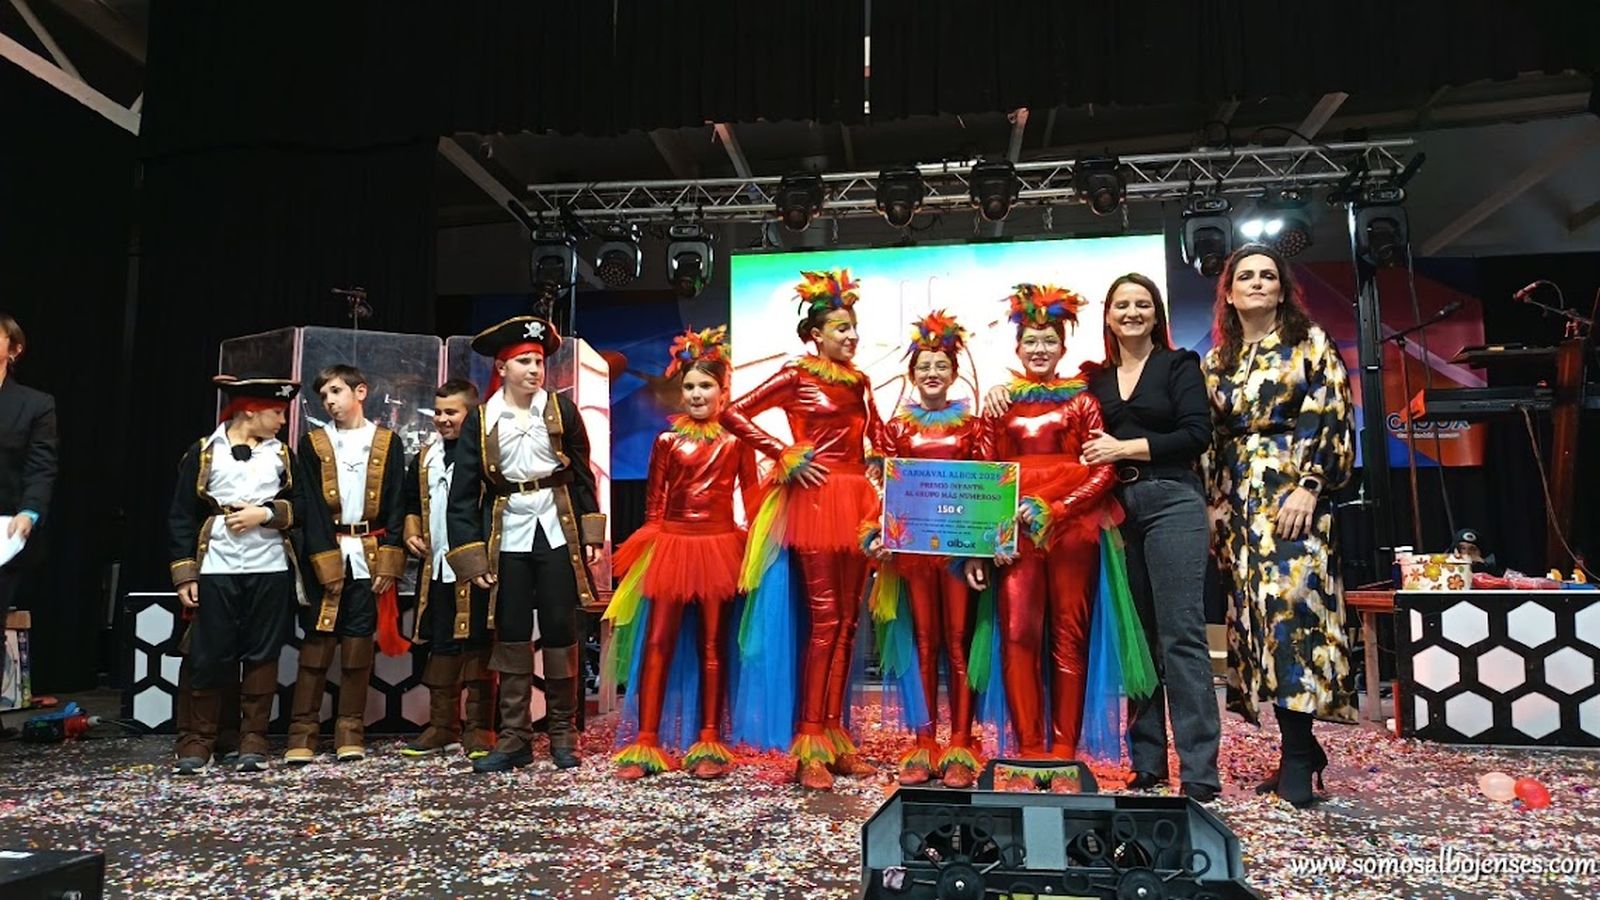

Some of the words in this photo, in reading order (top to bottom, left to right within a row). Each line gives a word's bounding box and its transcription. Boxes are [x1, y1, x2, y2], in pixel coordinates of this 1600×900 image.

[902, 469, 947, 478] CARNAVAL
[949, 471, 977, 479] ALBOX
[959, 493, 1002, 501] NUMEROSO
[937, 505, 955, 513] 150
[956, 505, 964, 514] €
[946, 538, 976, 549] albox
